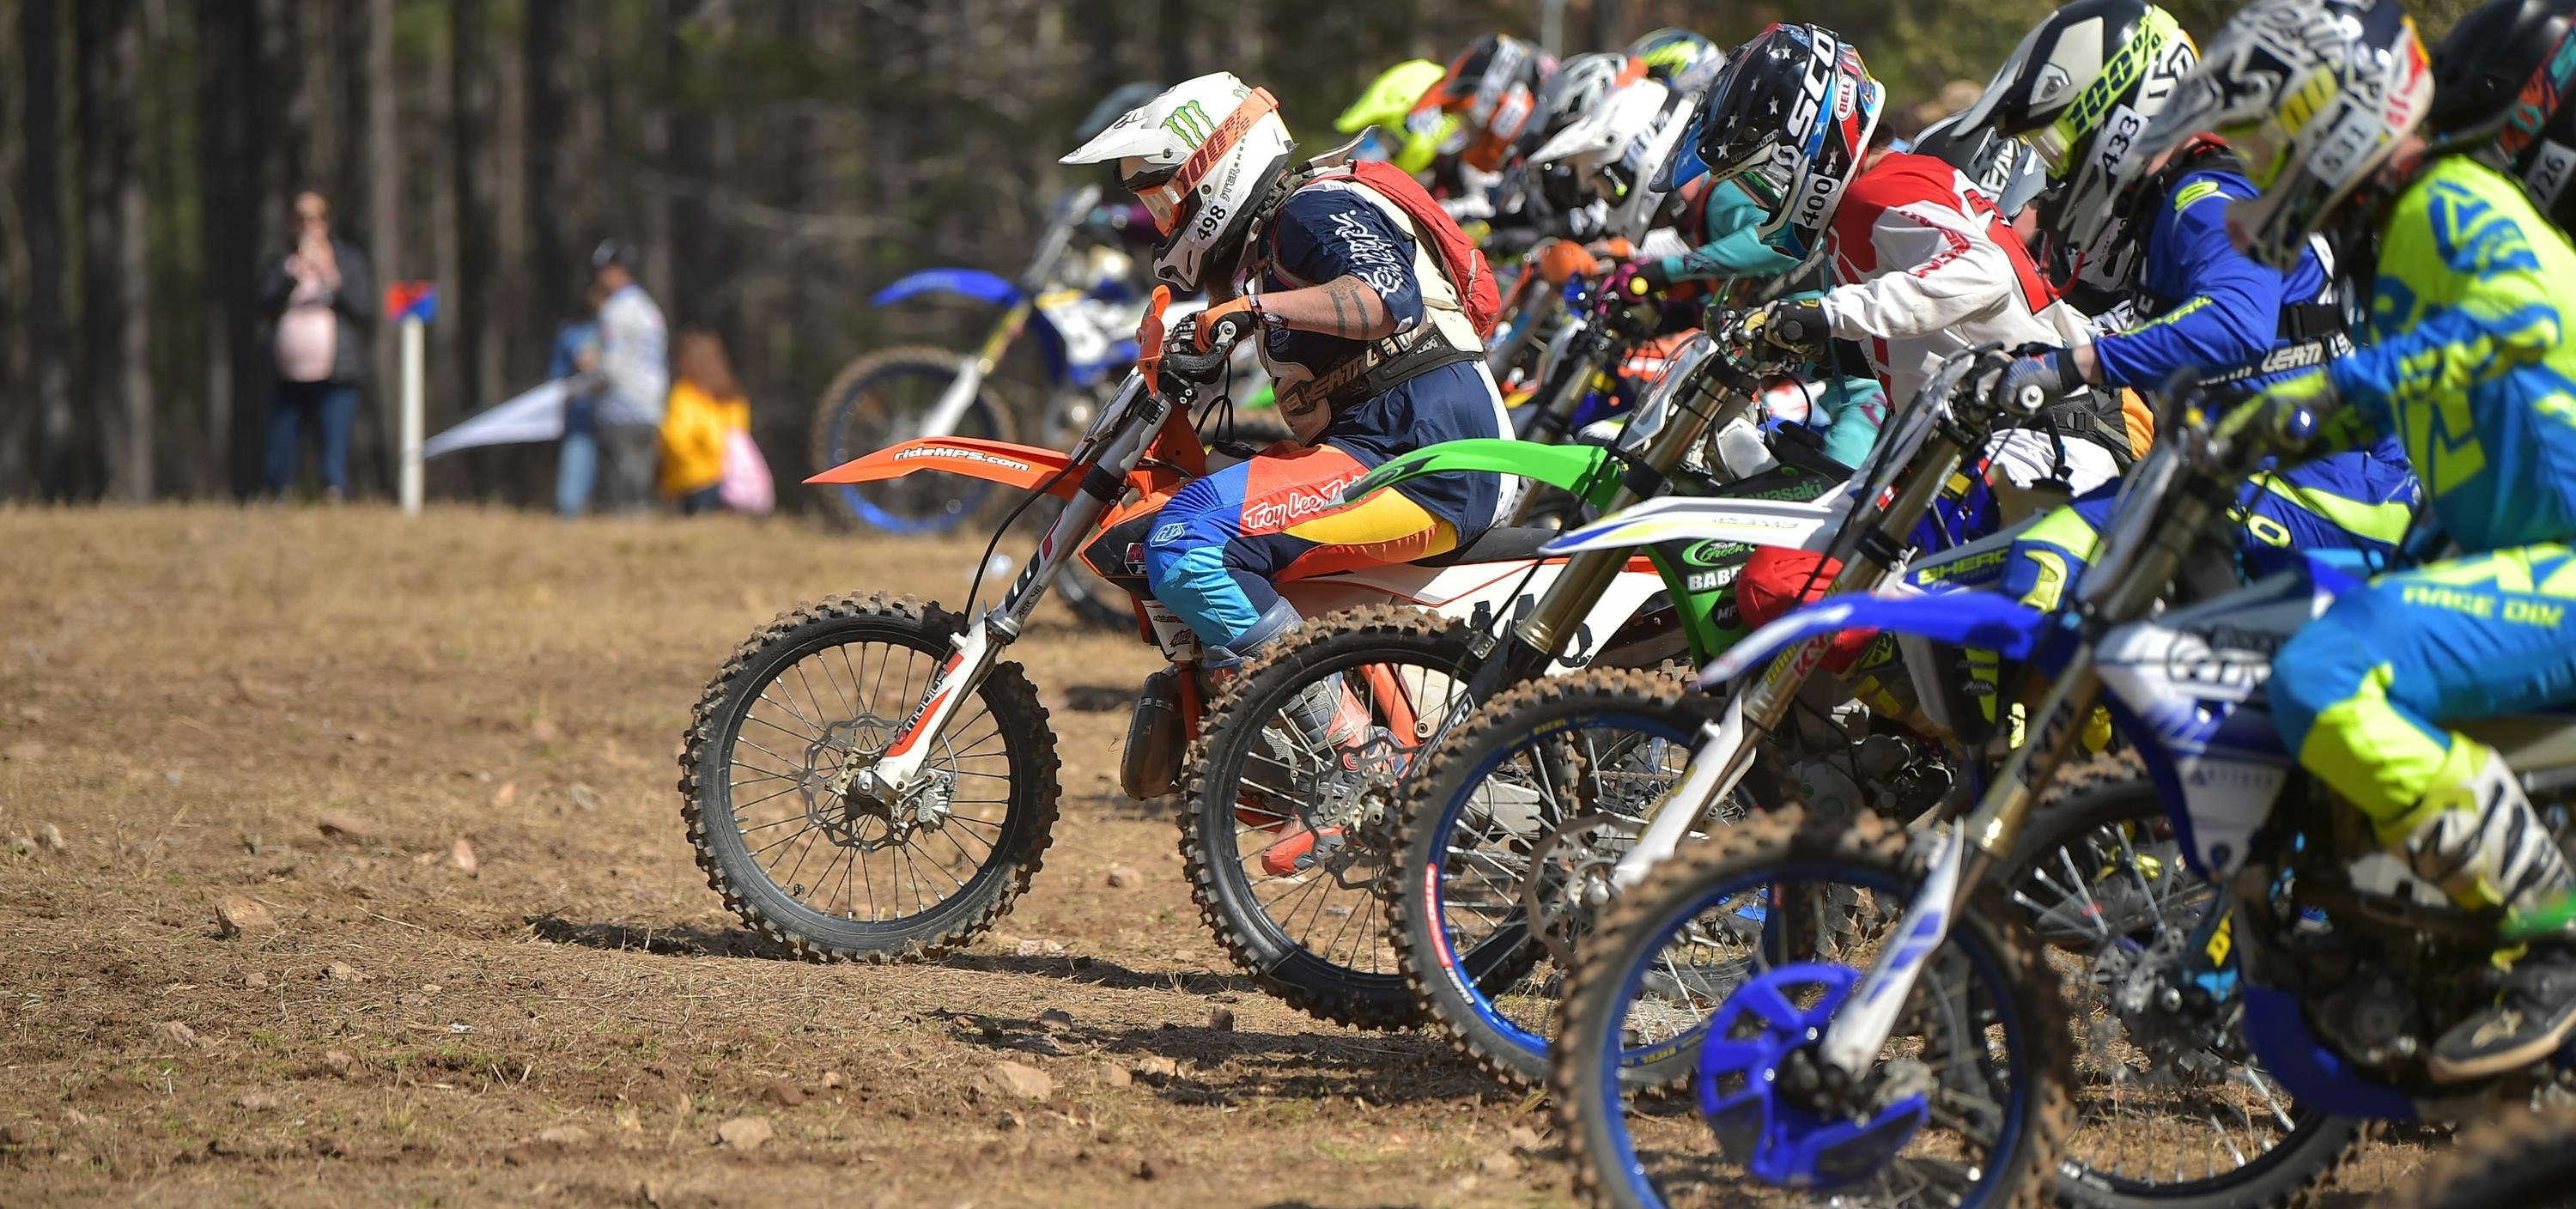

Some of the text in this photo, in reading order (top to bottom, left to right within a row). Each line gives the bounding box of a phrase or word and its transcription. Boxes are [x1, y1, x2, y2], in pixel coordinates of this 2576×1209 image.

[1838, 82, 1852, 113] BELL
[2066, 23, 2162, 136] 100%
[1176, 106, 1250, 196] 100%
[2102, 115, 2141, 173] 433
[1801, 178, 1832, 227] 400
[1197, 204, 1227, 241] 498
[2261, 342, 2324, 373] LEATT
[894, 447, 1030, 471] rideMPS.com
[1242, 492, 1324, 529] Troy Lee
[1700, 544, 1746, 562] Green
[1918, 548, 2009, 586] SHERC
[1018, 599, 1033, 619] AER
[1794, 634, 1828, 677] KY
